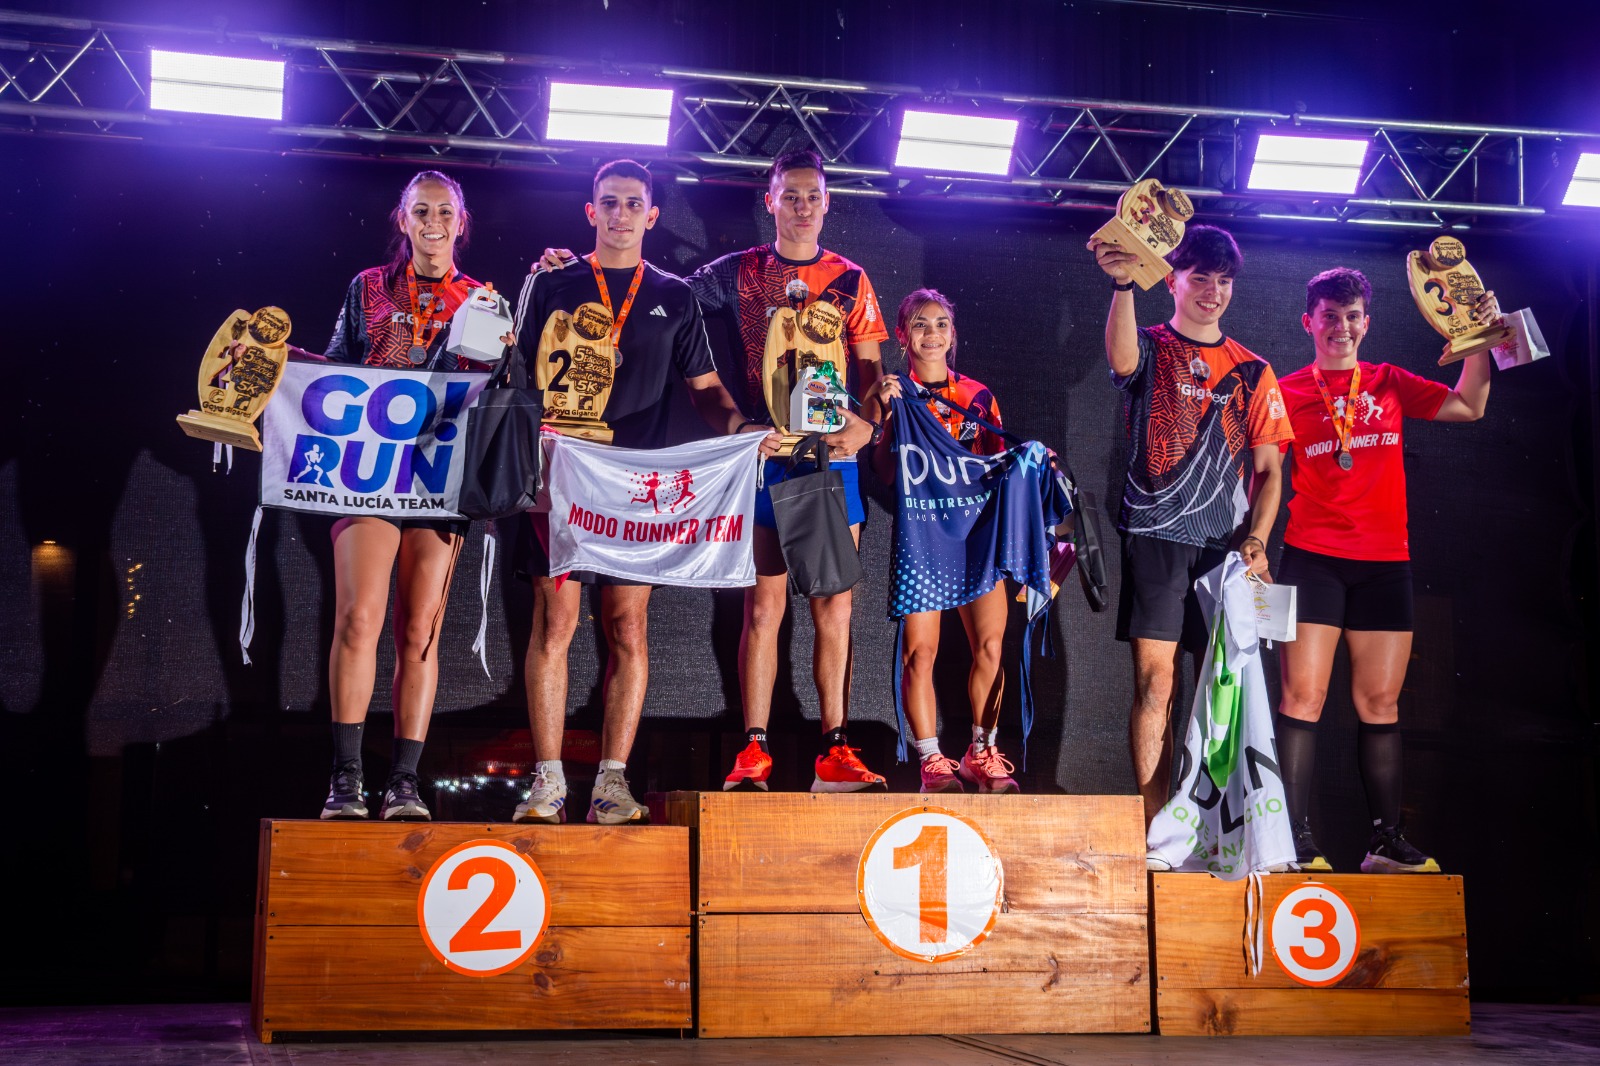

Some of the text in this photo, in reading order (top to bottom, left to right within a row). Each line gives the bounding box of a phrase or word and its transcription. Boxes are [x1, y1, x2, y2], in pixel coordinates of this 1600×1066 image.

[1423, 278, 1456, 316] 3
[1449, 325, 1468, 335] Goya
[548, 349, 572, 392] 2
[237, 380, 259, 394] 5K
[576, 380, 598, 392] 5K
[202, 401, 224, 412] Goya
[302, 374, 471, 442] GO!
[547, 406, 570, 416] Goya
[571, 410, 598, 418] Gigared
[1305, 440, 1332, 459] MODO
[287, 434, 454, 494] RUN
[284, 489, 445, 510] SANTA LUCÍA TEAM
[567, 502, 744, 545] MODO RUNNER TEAM
[907, 513, 949, 522] LAURA
[749, 734, 767, 742] SOX
[893, 825, 948, 944] 1
[447, 856, 522, 953] 2
[1289, 898, 1341, 970] 3
